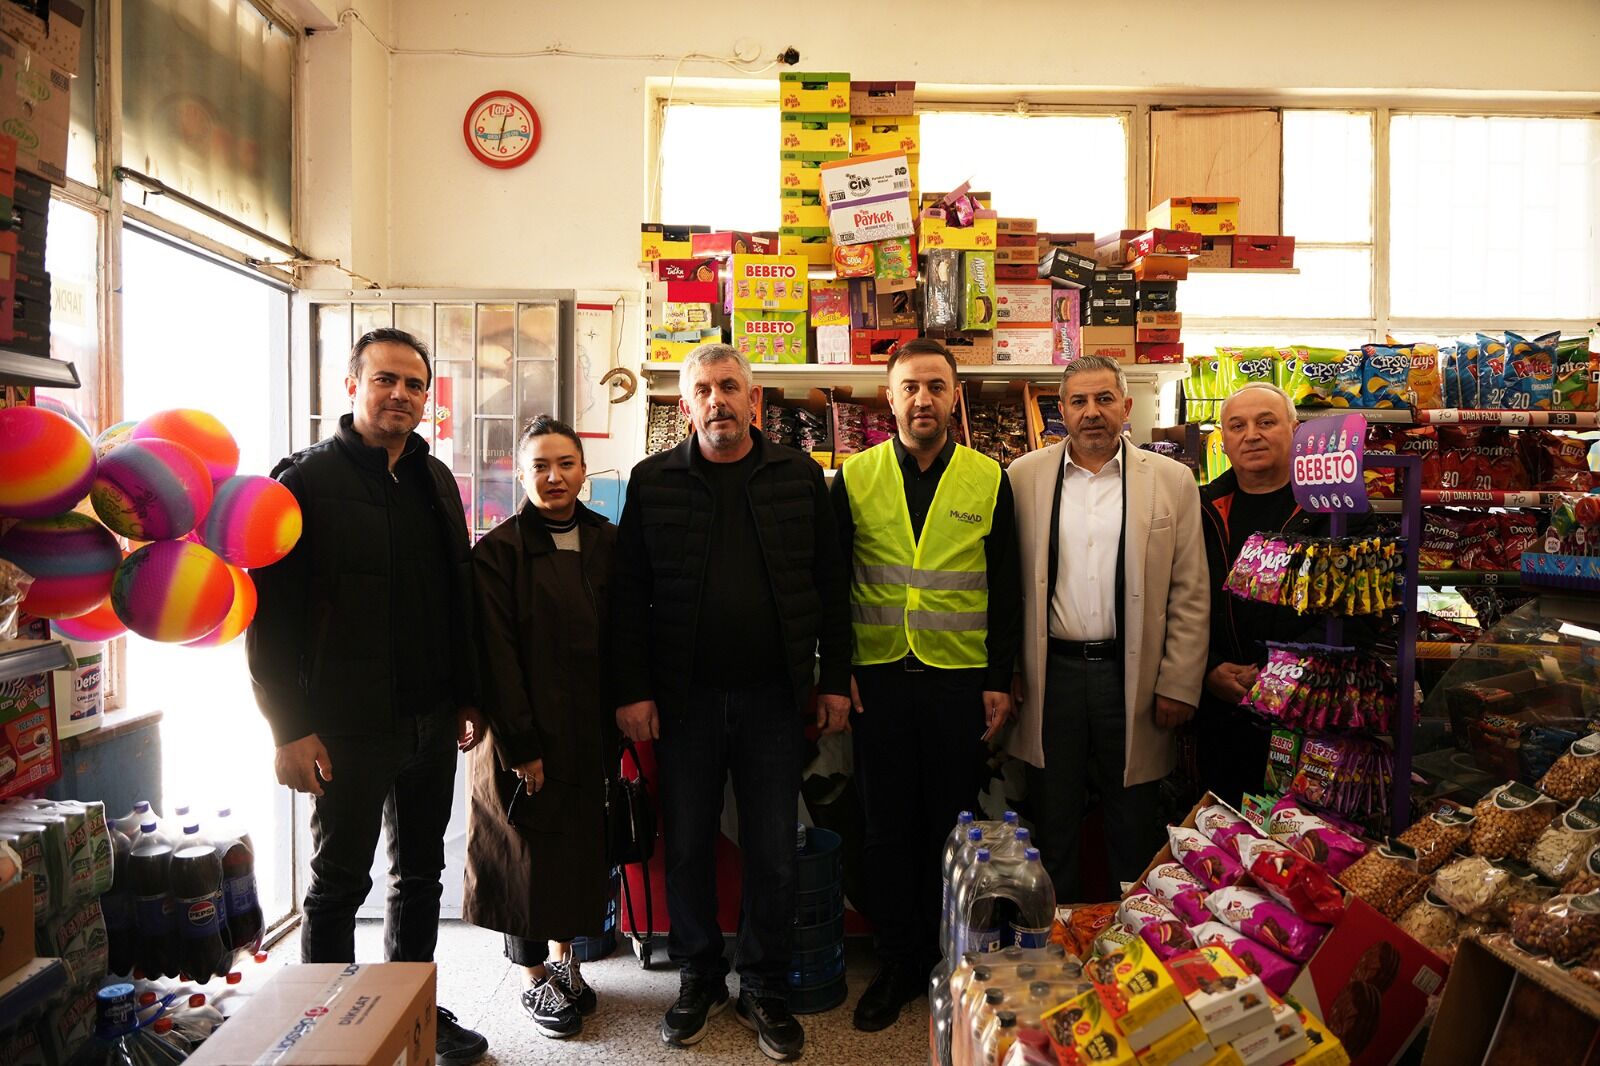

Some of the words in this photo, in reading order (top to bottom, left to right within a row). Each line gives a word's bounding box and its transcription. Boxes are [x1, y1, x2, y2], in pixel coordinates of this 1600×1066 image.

[521, 125, 527, 133] 3
[746, 265, 796, 278] BEBETO
[746, 321, 795, 334] BEBETO
[1462, 411, 1481, 420] DAHA
[1296, 454, 1357, 483] BEBETO
[1453, 492, 1472, 500] DAHA
[1473, 492, 1493, 500] FAZLA
[75, 674, 101, 692] Detsa
